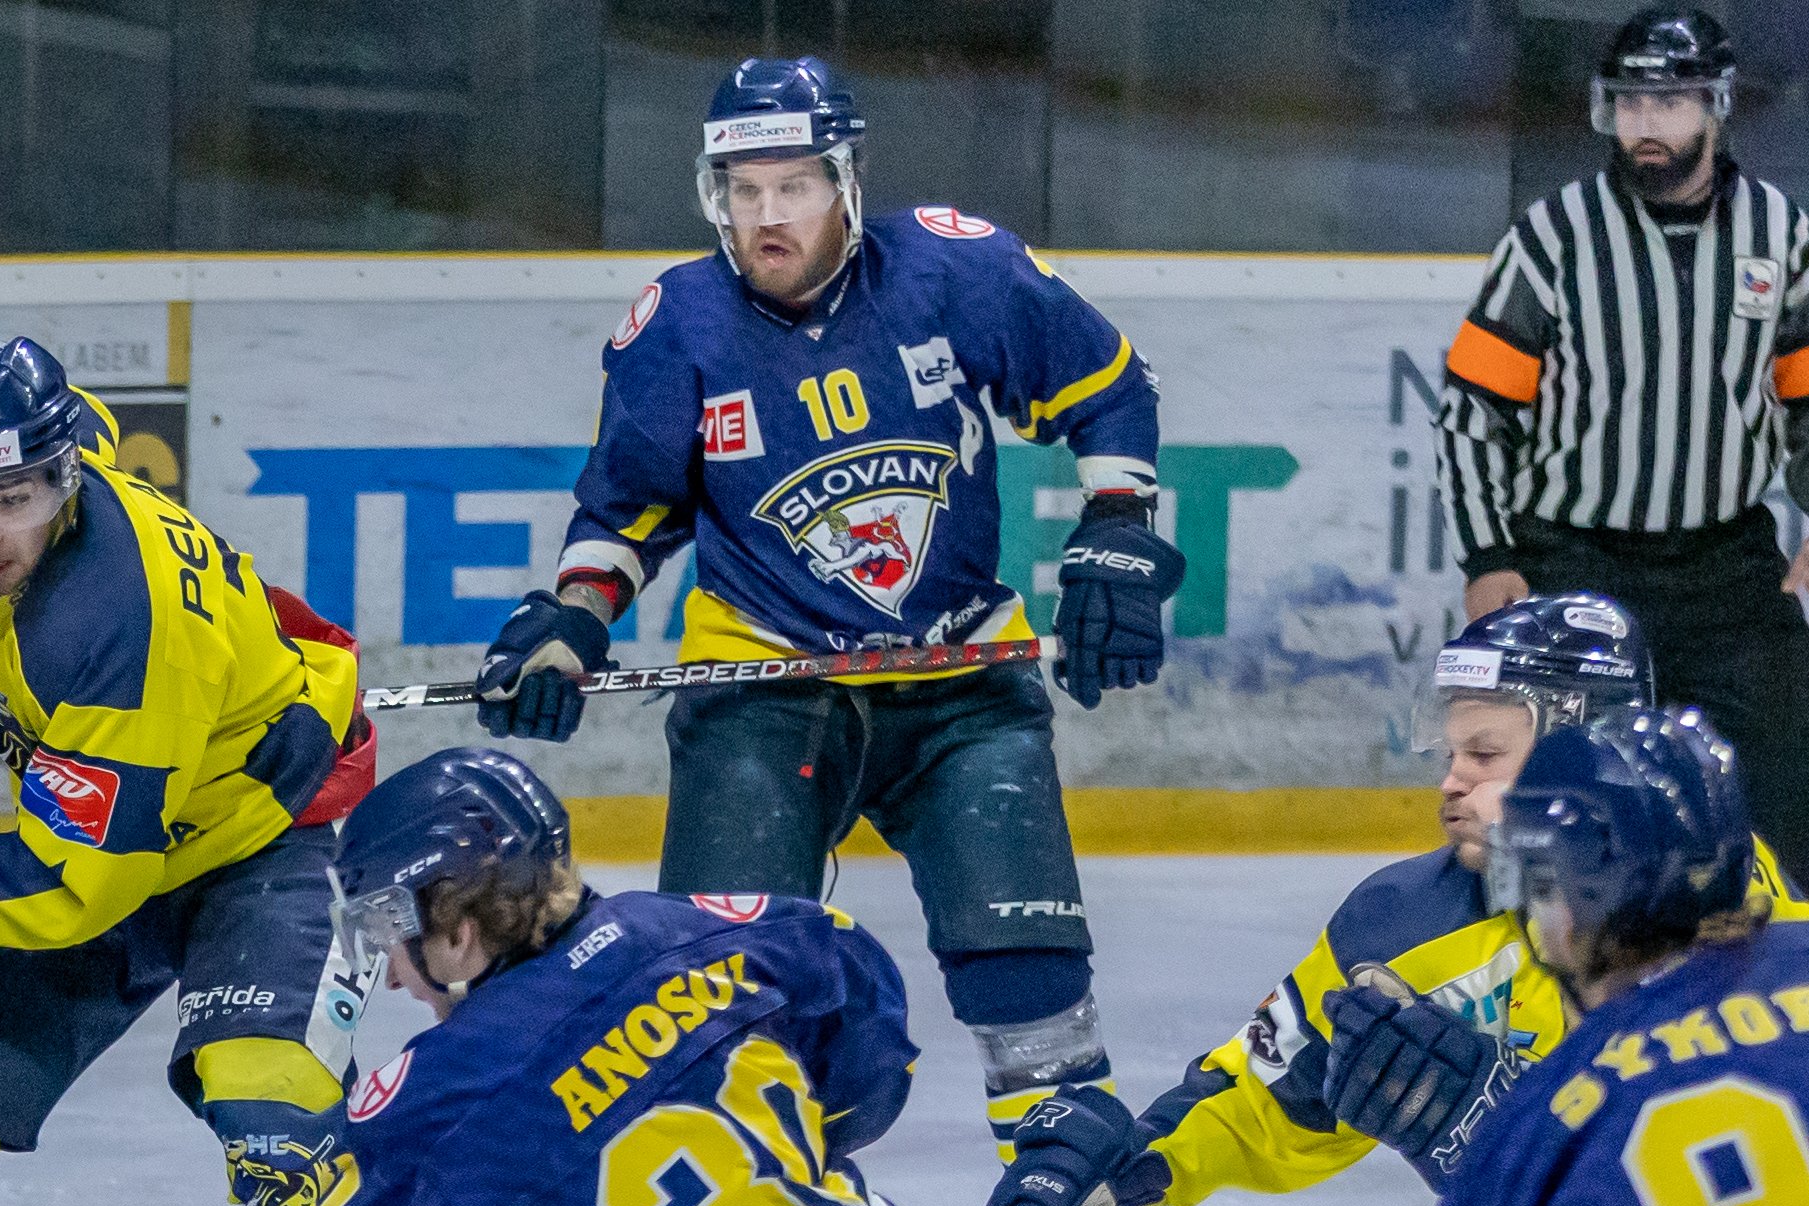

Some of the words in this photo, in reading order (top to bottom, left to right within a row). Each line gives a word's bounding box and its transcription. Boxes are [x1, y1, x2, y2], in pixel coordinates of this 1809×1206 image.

[729, 122, 761, 132] CZECH
[797, 368, 871, 441] 10
[780, 456, 938, 527] SLOVAN
[1062, 546, 1156, 577] CHER
[579, 659, 788, 693] JETSPEED
[1578, 662, 1636, 679] BAUER
[394, 852, 443, 885] CCM
[1432, 1035, 1523, 1174] AUER
[246, 1133, 290, 1156] HC
